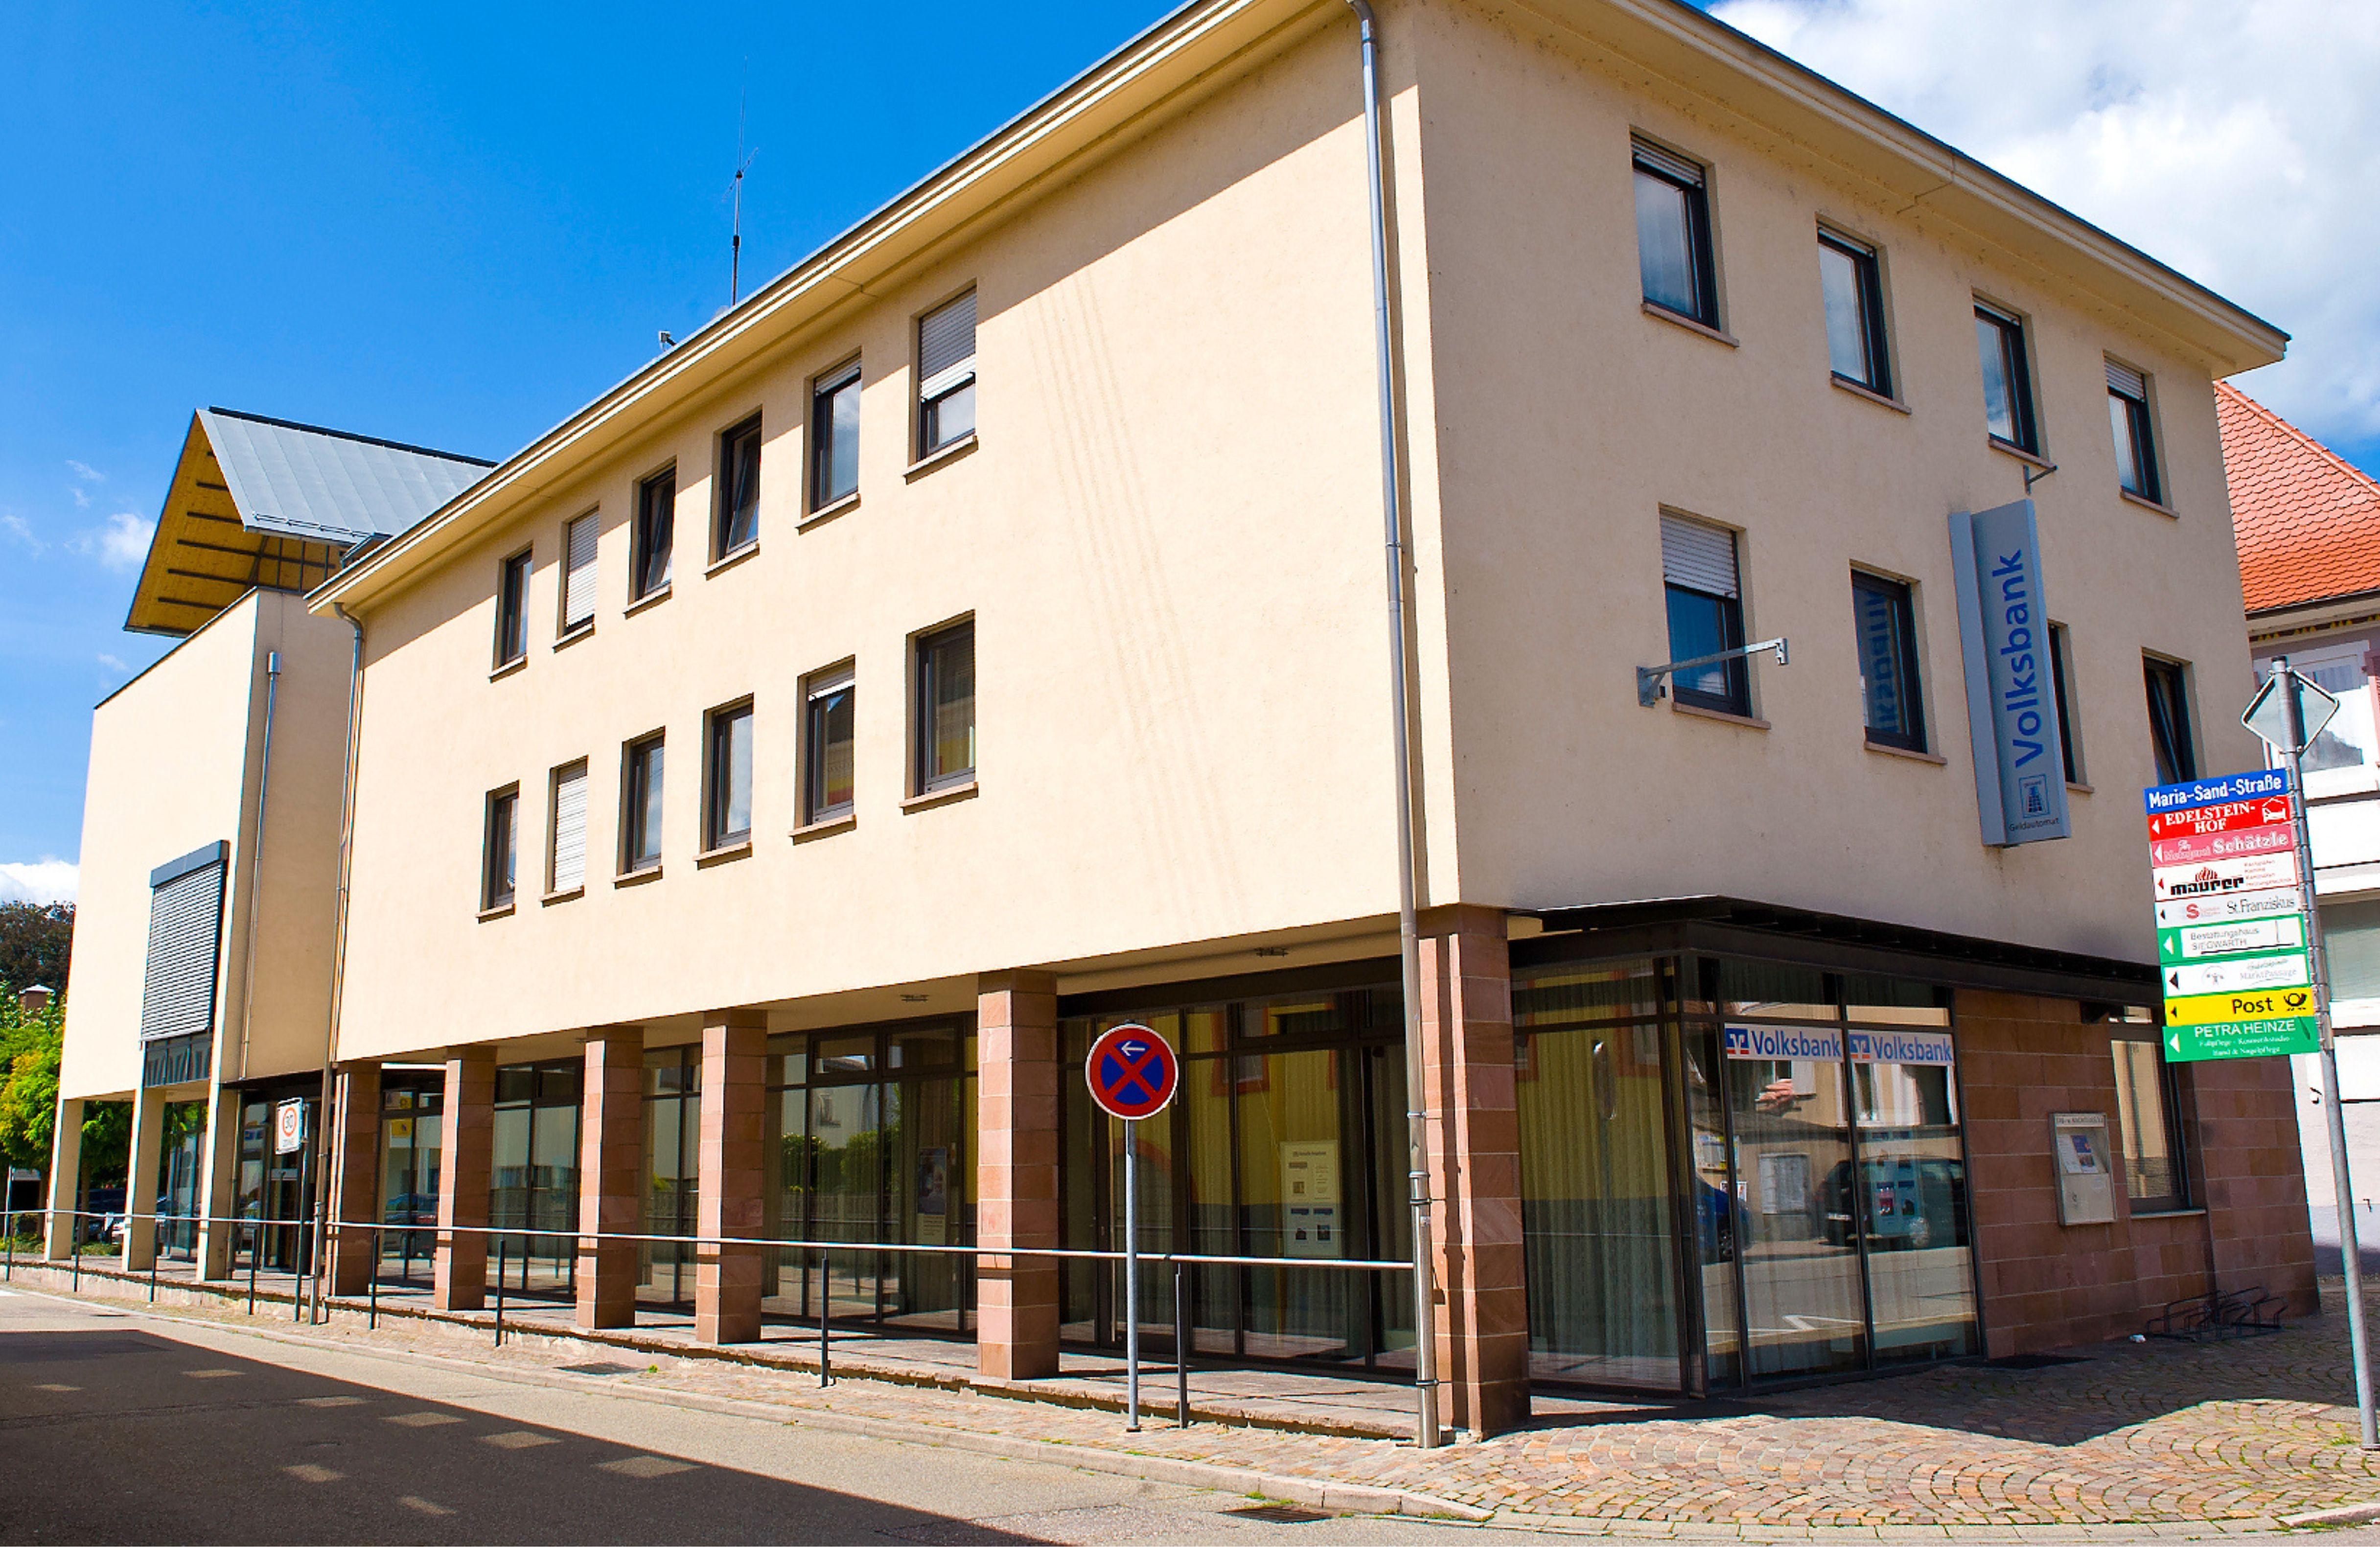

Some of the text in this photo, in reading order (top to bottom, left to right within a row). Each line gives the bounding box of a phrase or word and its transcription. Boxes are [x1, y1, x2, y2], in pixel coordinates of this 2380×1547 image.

[1991, 548, 2044, 768] Volksbank
[2149, 774, 2282, 809] Maria-Sand-Straße
[2165, 801, 2256, 826] EDELSTEIN-
[2195, 818, 2227, 834] HOF
[2213, 831, 2289, 855] Schätzle
[2170, 877, 2244, 896] maurer
[2190, 927, 2260, 941] Bestattungshaus
[2192, 938, 2247, 950] SIEGWARTH
[2232, 997, 2274, 1014] Post
[2195, 1019, 2296, 1038] PETRA HEINZE
[1750, 1030, 1842, 1058] Volksbank
[1872, 1036, 1953, 1062] Volksbank
[285, 1114, 294, 1129] 30
